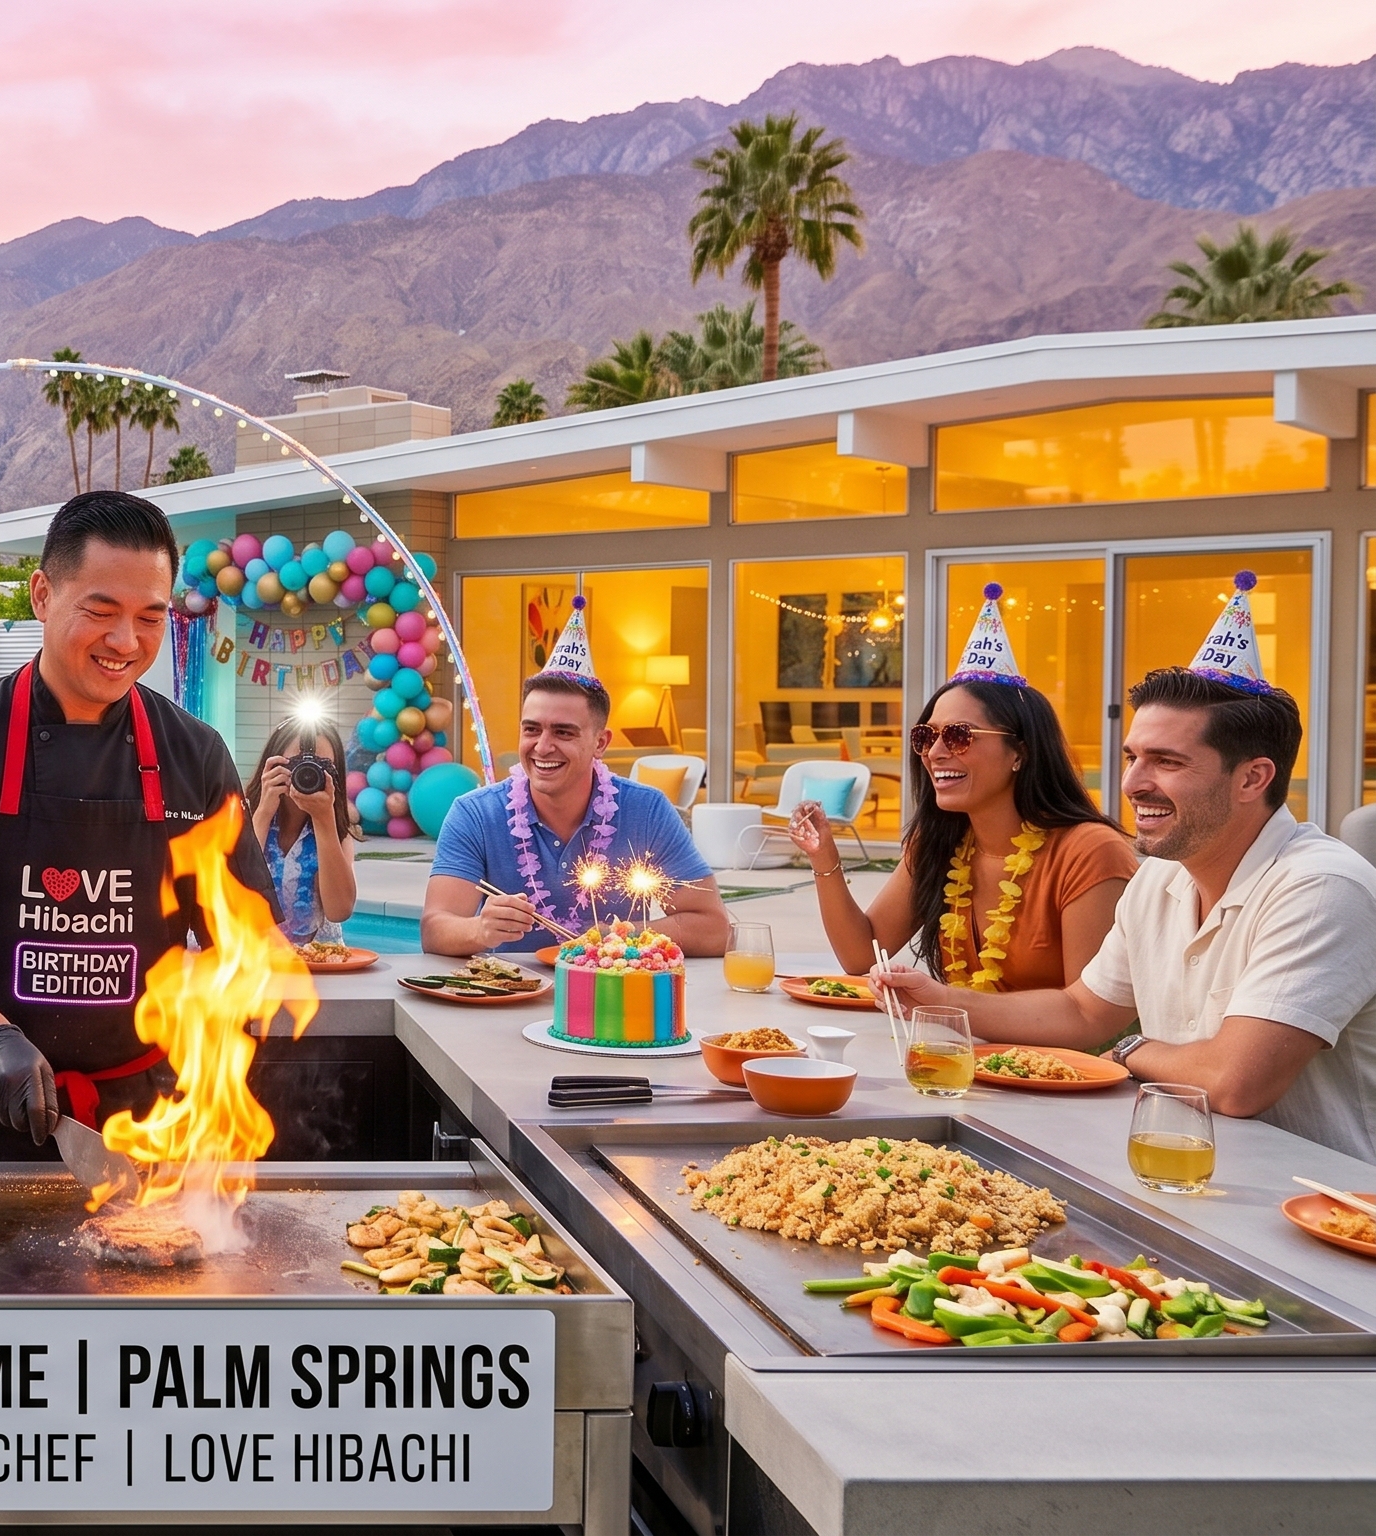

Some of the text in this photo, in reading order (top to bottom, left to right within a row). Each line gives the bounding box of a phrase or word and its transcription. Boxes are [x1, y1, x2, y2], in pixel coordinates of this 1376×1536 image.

[19, 904, 134, 933] Hibachi
[23, 950, 130, 973] BIRTHDAY
[32, 974, 120, 995] EDITION
[120, 1345, 269, 1408] PALM
[291, 1345, 529, 1409] SPRINGS
[166, 1434, 274, 1482] LOVE
[295, 1434, 469, 1482] HIBACHI
